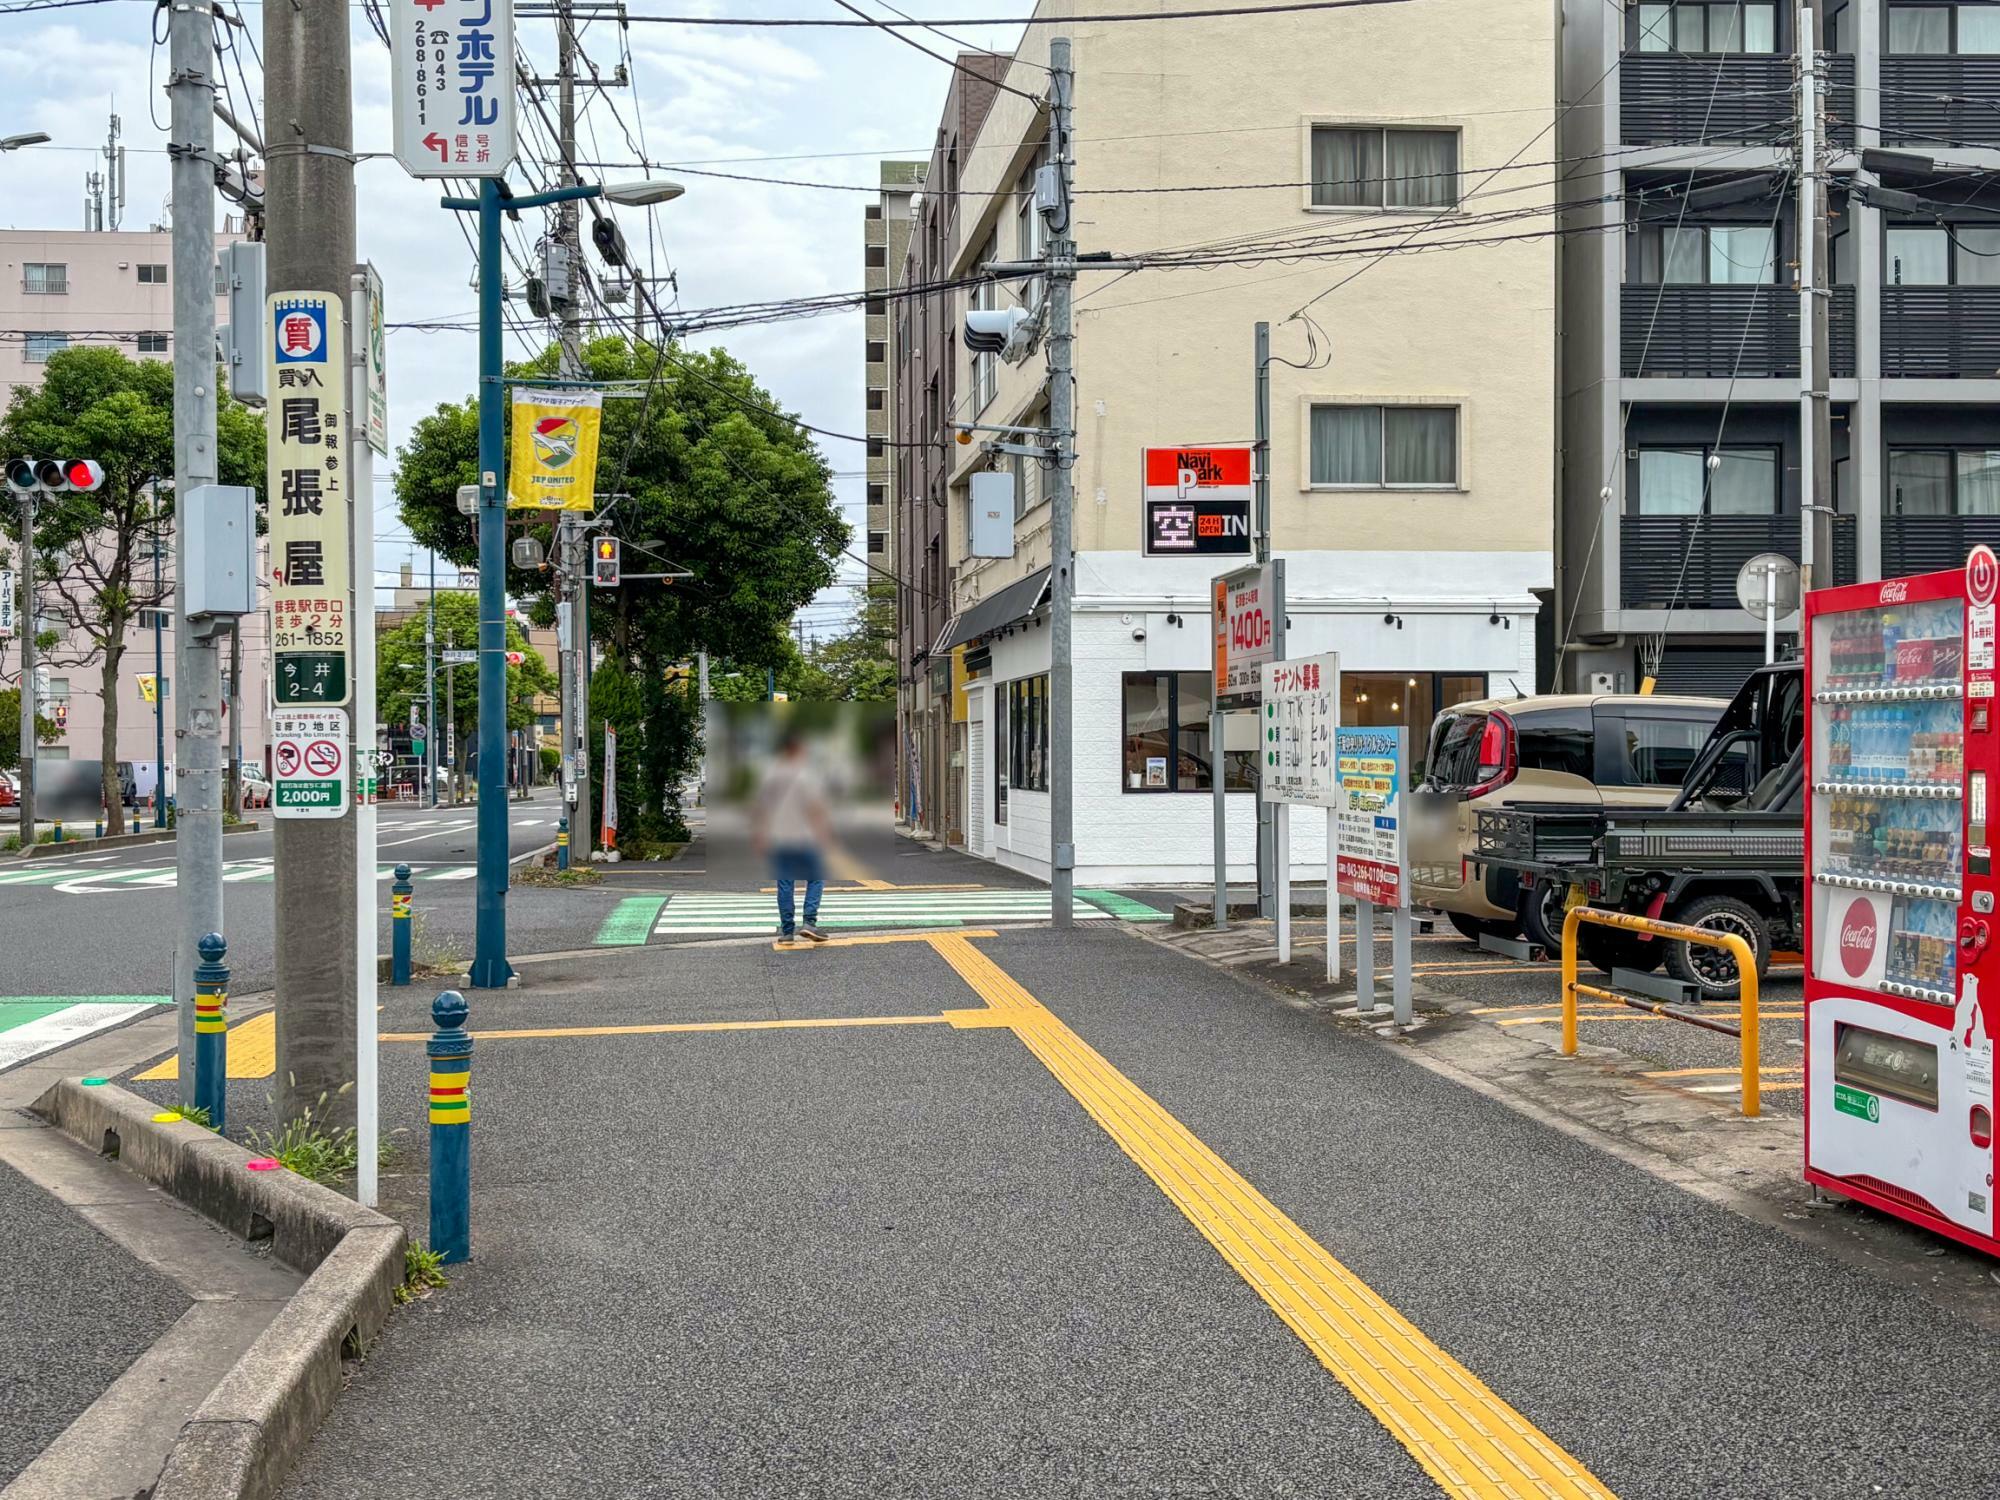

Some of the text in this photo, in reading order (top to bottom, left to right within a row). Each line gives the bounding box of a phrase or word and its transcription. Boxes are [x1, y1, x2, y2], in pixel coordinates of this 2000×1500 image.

[415, 20, 427, 126] 268-8611
[435, 49, 447, 92] 043
[455, 134, 490, 149] 信号
[455, 149, 490, 163] 左折
[285, 317, 313, 353] 質
[1177, 452, 1212, 470] Navi
[280, 398, 325, 586] 尾張屋
[1178, 464, 1224, 499] Park
[1153, 506, 1195, 547] 空
[1200, 525, 1219, 534] OPEN
[1221, 515, 1248, 536] IN
[2, 571, 11, 627] アーバンホテル
[275, 631, 344, 647] 261-1852
[1231, 608, 1271, 652] 1400円
[284, 661, 331, 678] 今井
[1274, 663, 1320, 693] テナント募集
[289, 682, 324, 697] 2-4
[282, 790, 330, 803] 2,000円
[1841, 924, 1876, 950] Coca-Cola
